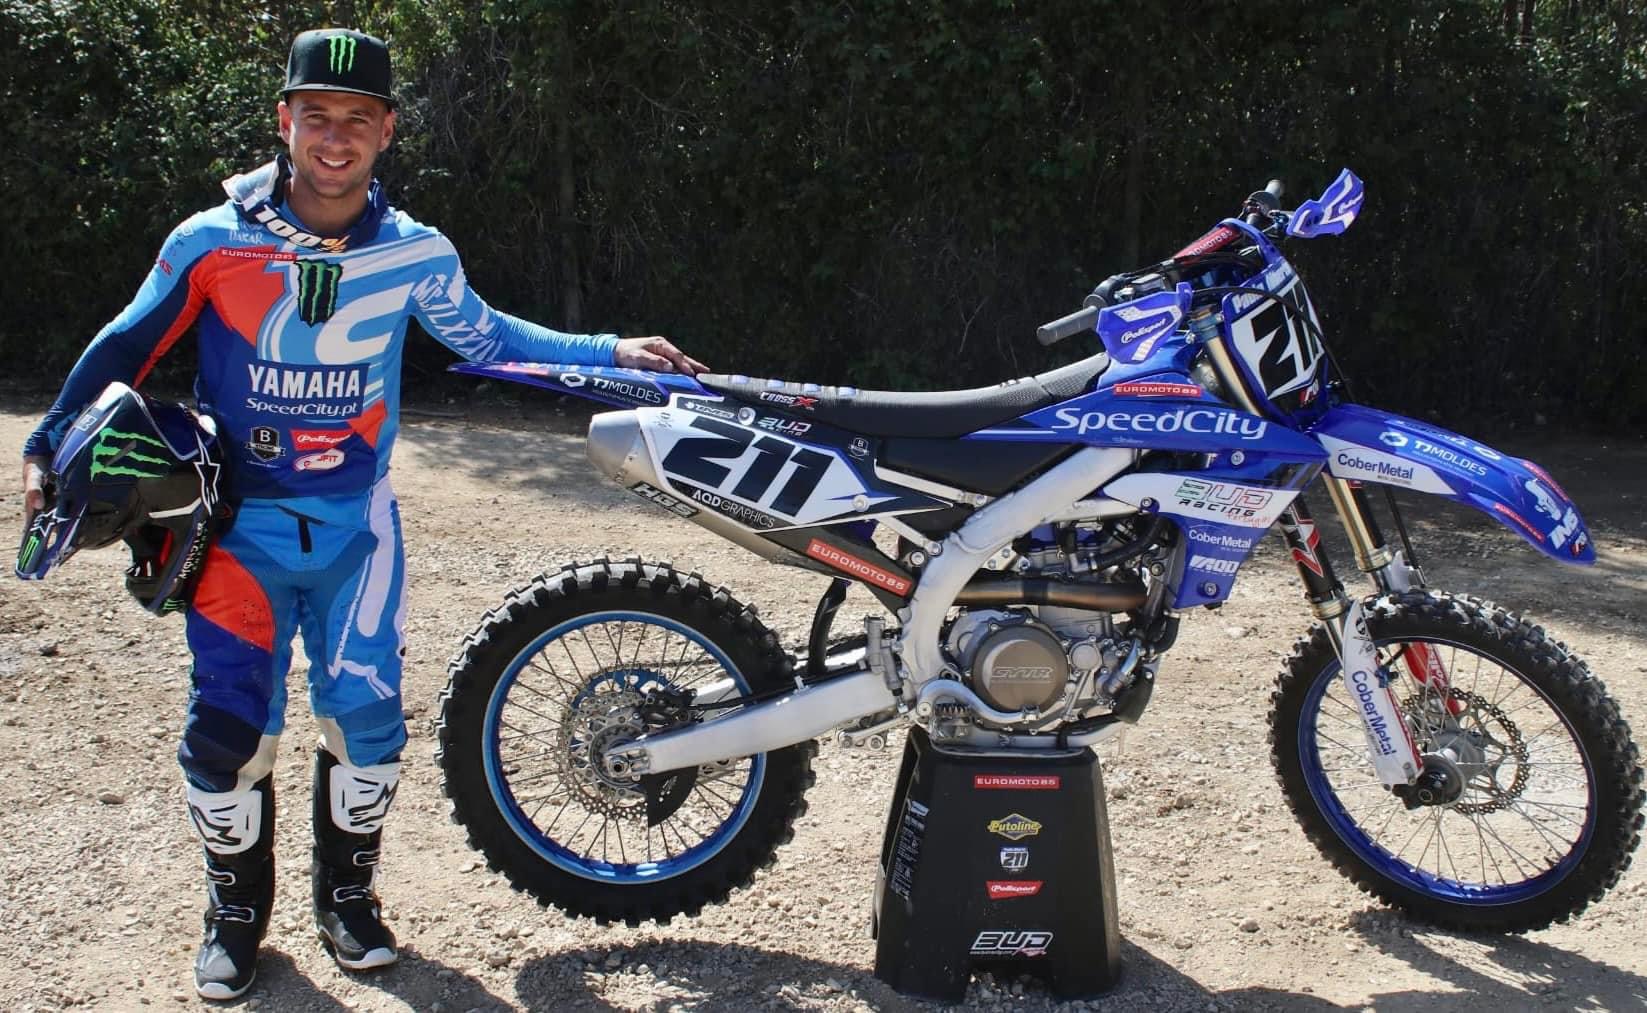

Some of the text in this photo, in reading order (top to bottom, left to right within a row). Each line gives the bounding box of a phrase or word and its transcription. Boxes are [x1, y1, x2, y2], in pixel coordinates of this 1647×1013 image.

[247, 363, 360, 399] YAMAHA
[1115, 386, 1199, 395] EUROMOTO85
[1051, 407, 1268, 440] SpeedCity
[260, 429, 271, 442] B
[662, 415, 835, 518] 211
[811, 543, 906, 591] EUROMOTO85
[976, 778, 1056, 786] EUROMOTO85
[1003, 853, 1028, 866] 211
